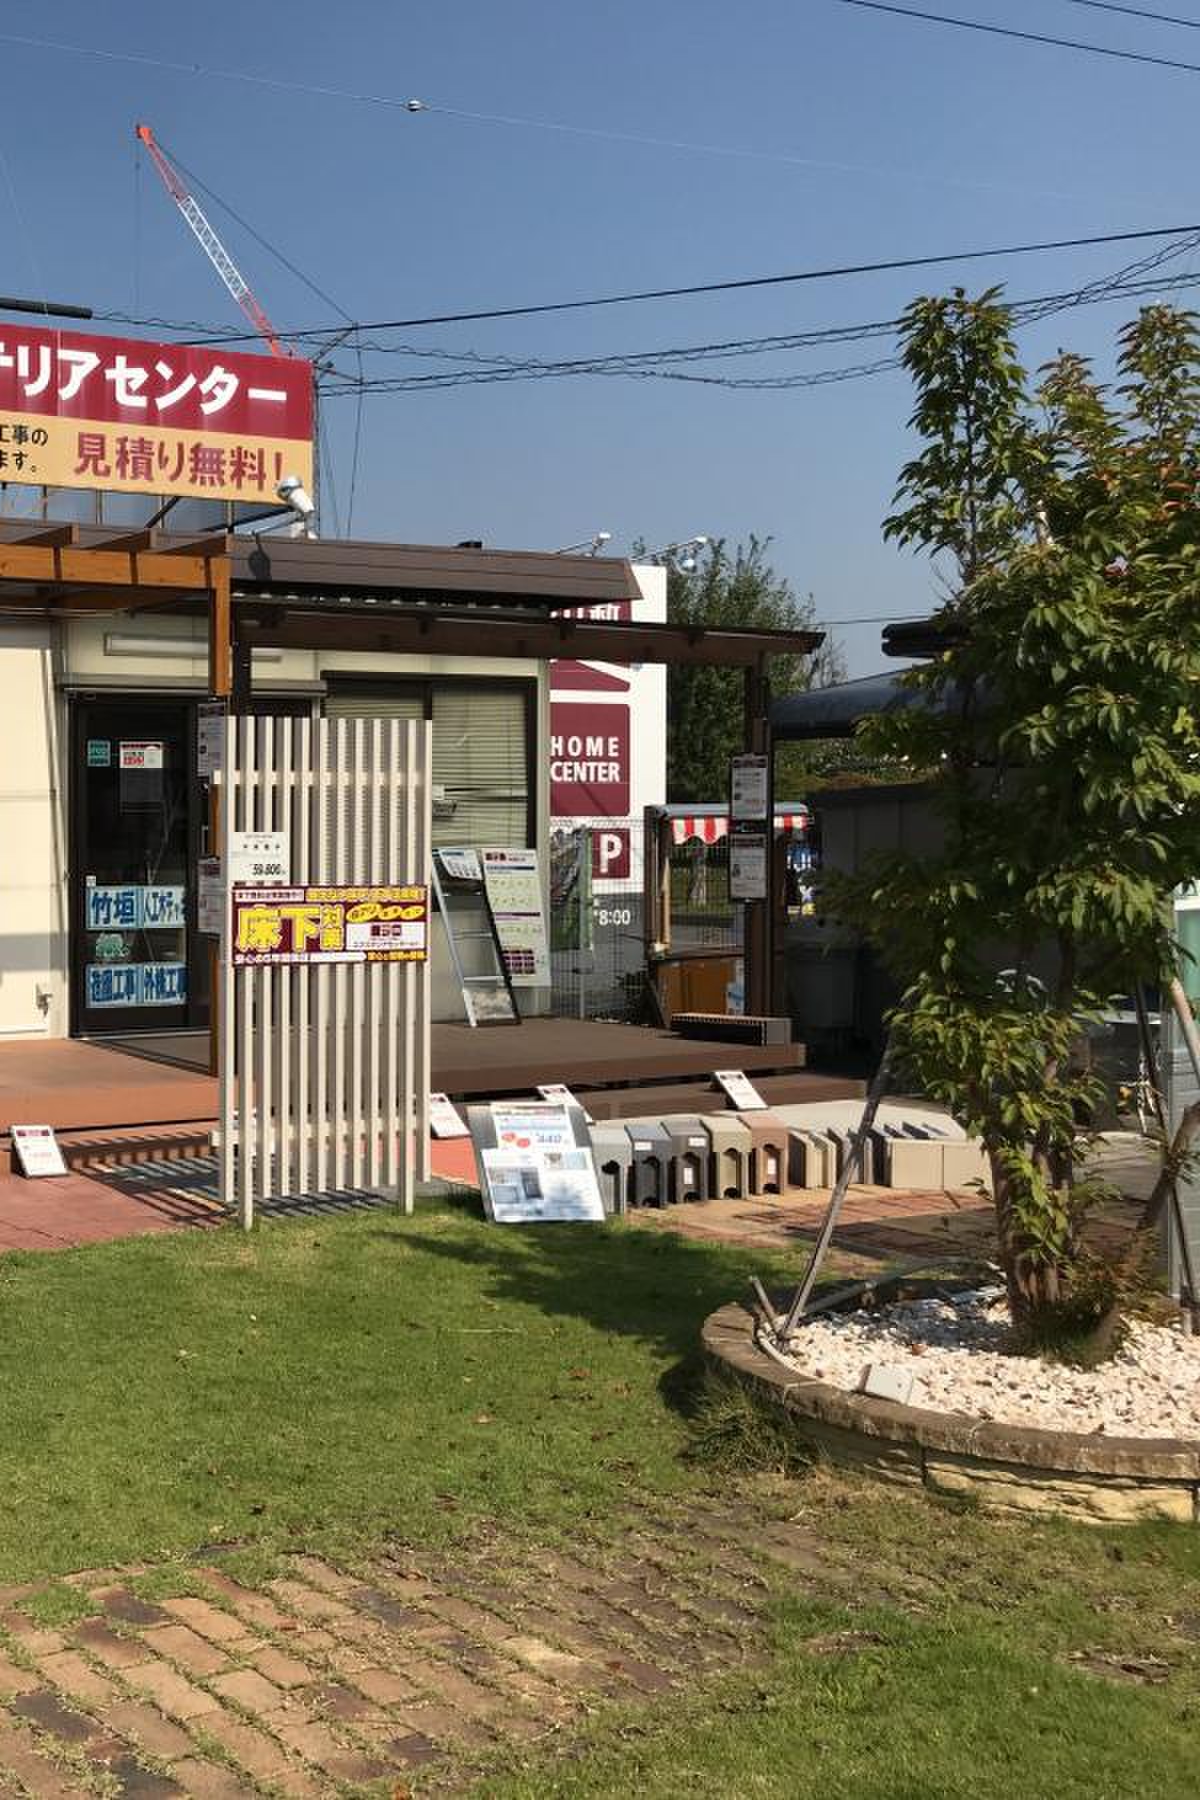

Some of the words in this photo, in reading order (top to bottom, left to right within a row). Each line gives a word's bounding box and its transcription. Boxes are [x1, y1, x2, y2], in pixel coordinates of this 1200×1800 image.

[550, 735, 620, 757] HOME
[550, 761, 621, 783] CENTER
[599, 833, 623, 873] P
